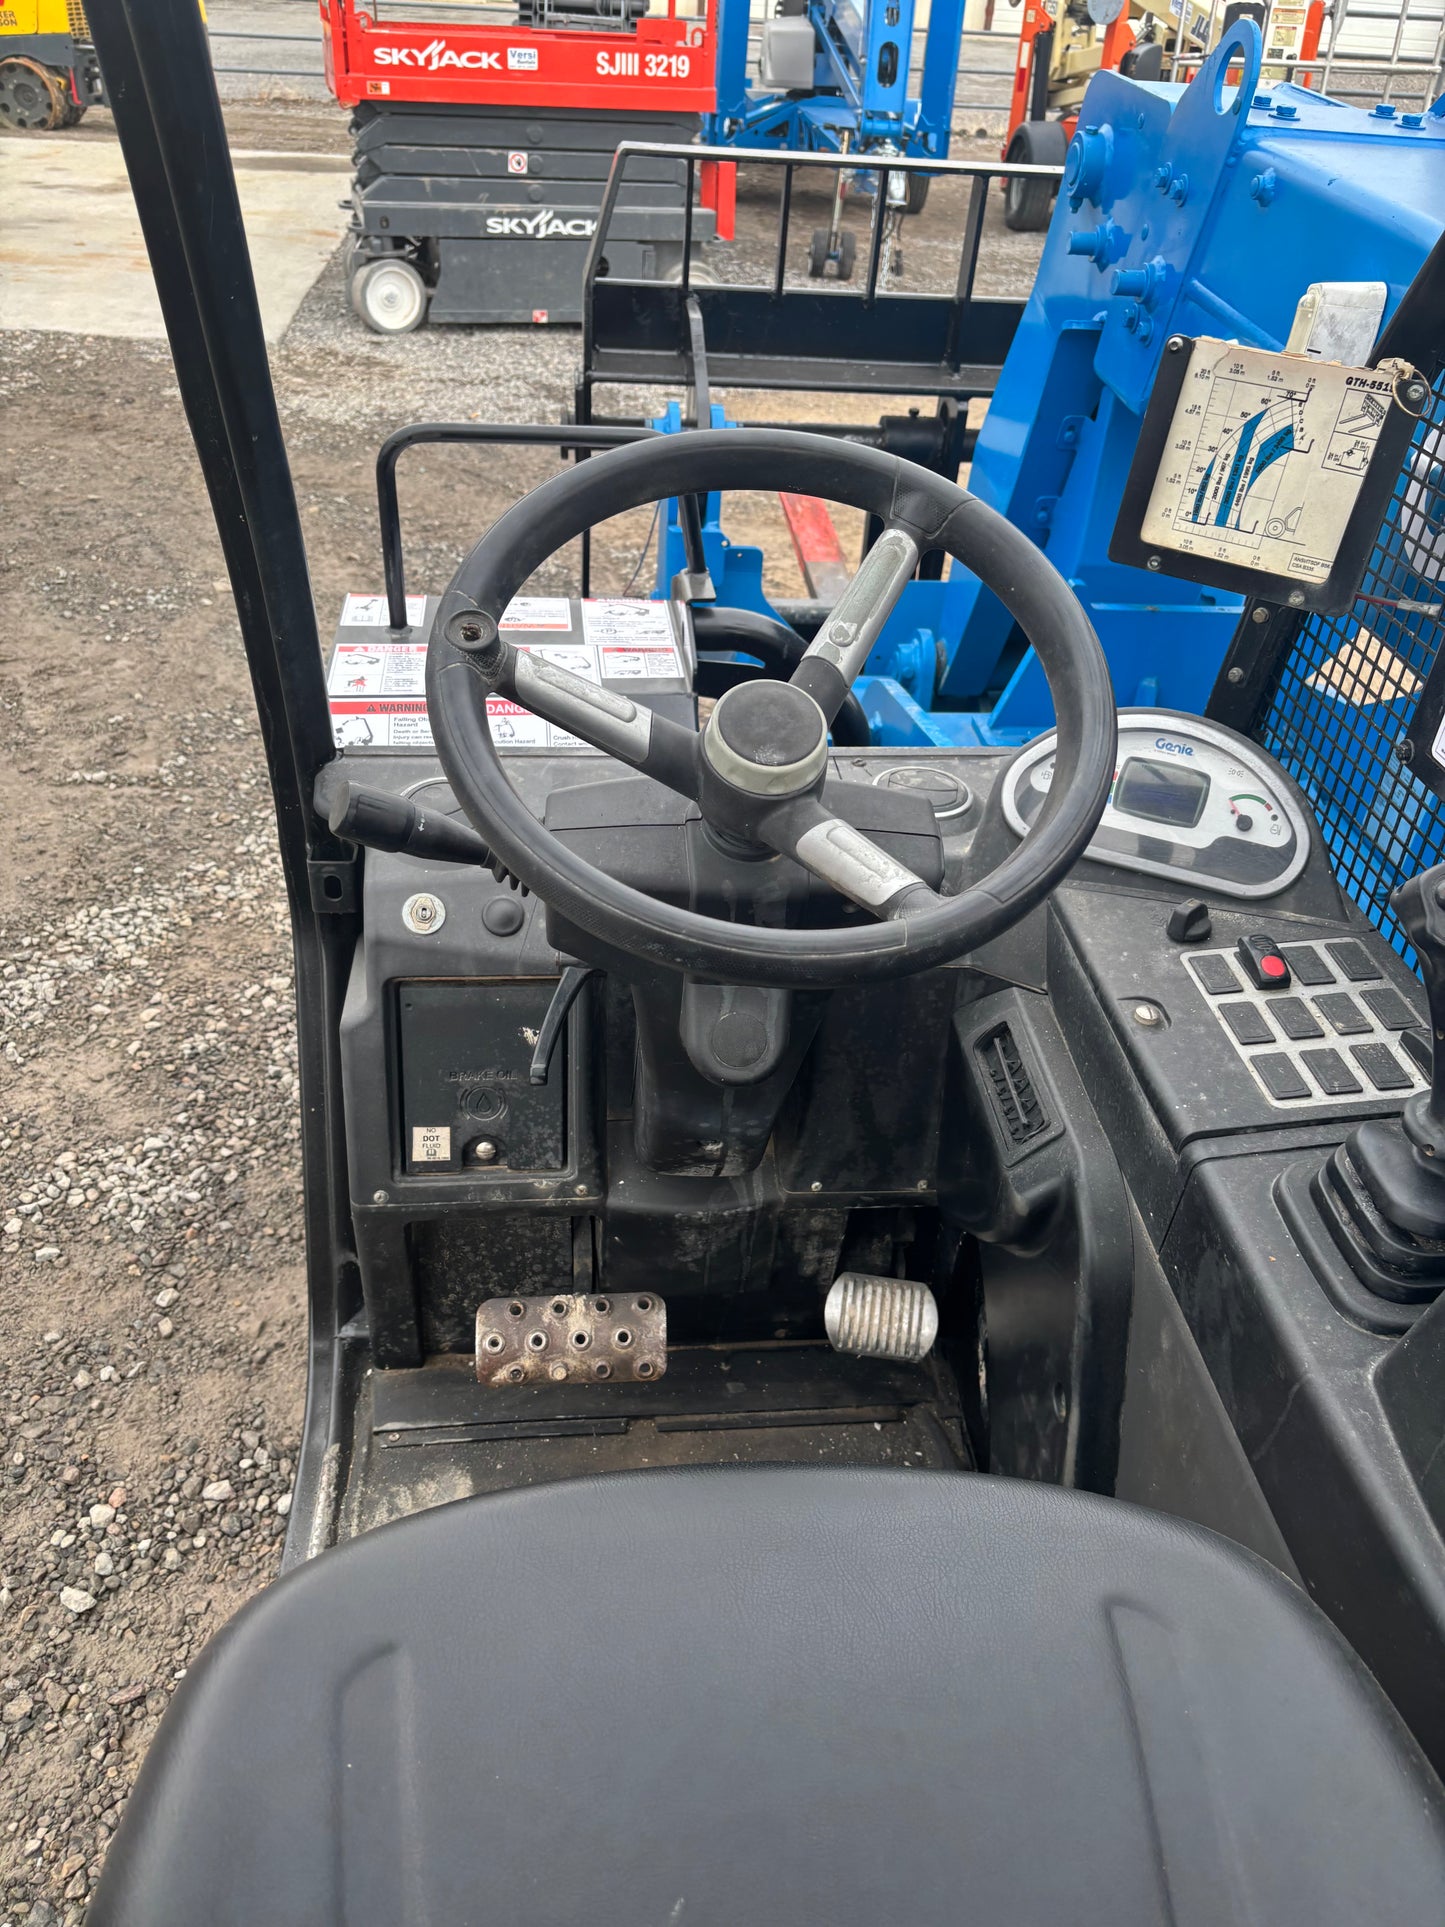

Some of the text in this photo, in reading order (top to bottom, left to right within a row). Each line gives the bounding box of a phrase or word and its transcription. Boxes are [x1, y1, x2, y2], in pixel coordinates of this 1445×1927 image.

[374, 40, 503, 71] SKYJACK
[510, 50, 536, 59] Versi
[644, 54, 690, 78] 3219
[1155, 738, 1194, 756] Genie
[450, 1070, 518, 1081] BRAKE OIL
